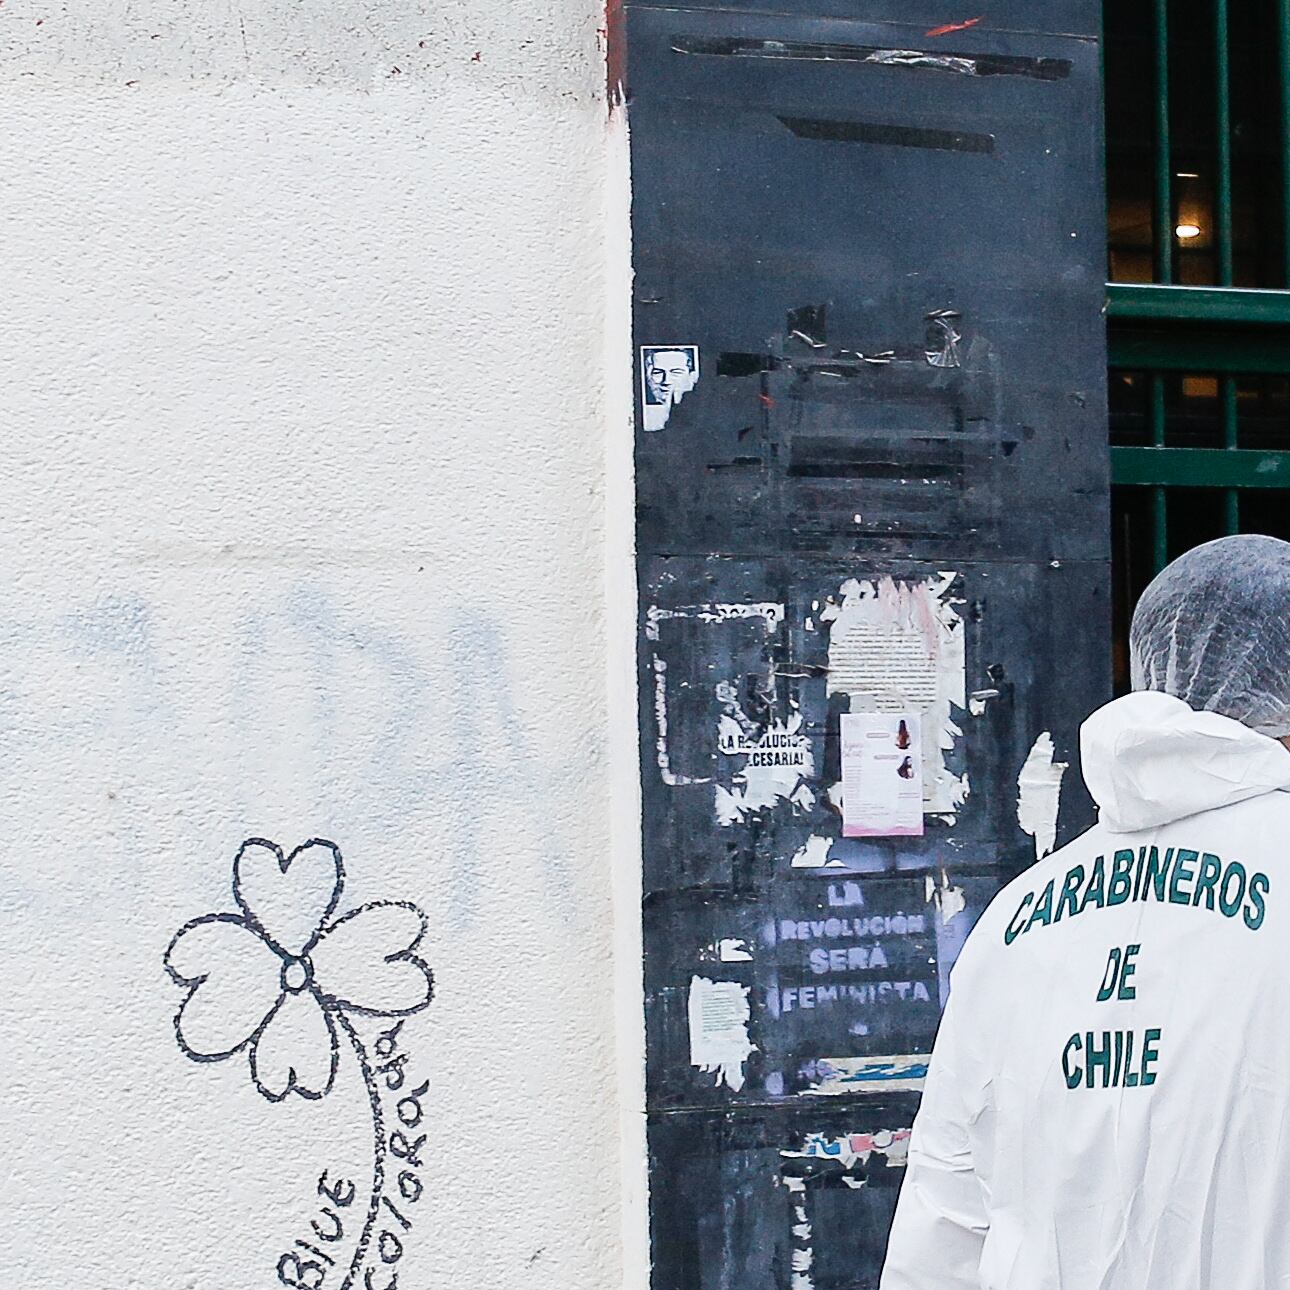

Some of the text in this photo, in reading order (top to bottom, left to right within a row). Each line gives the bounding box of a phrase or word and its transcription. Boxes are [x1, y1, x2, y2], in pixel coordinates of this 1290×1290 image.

[828, 881, 865, 907] LA
[1004, 845, 1270, 946] CARABINEROS
[782, 981, 932, 1013] FEMINISTA
[1096, 944, 1142, 1002] DE
[1061, 1028, 1162, 1090] CHILE
